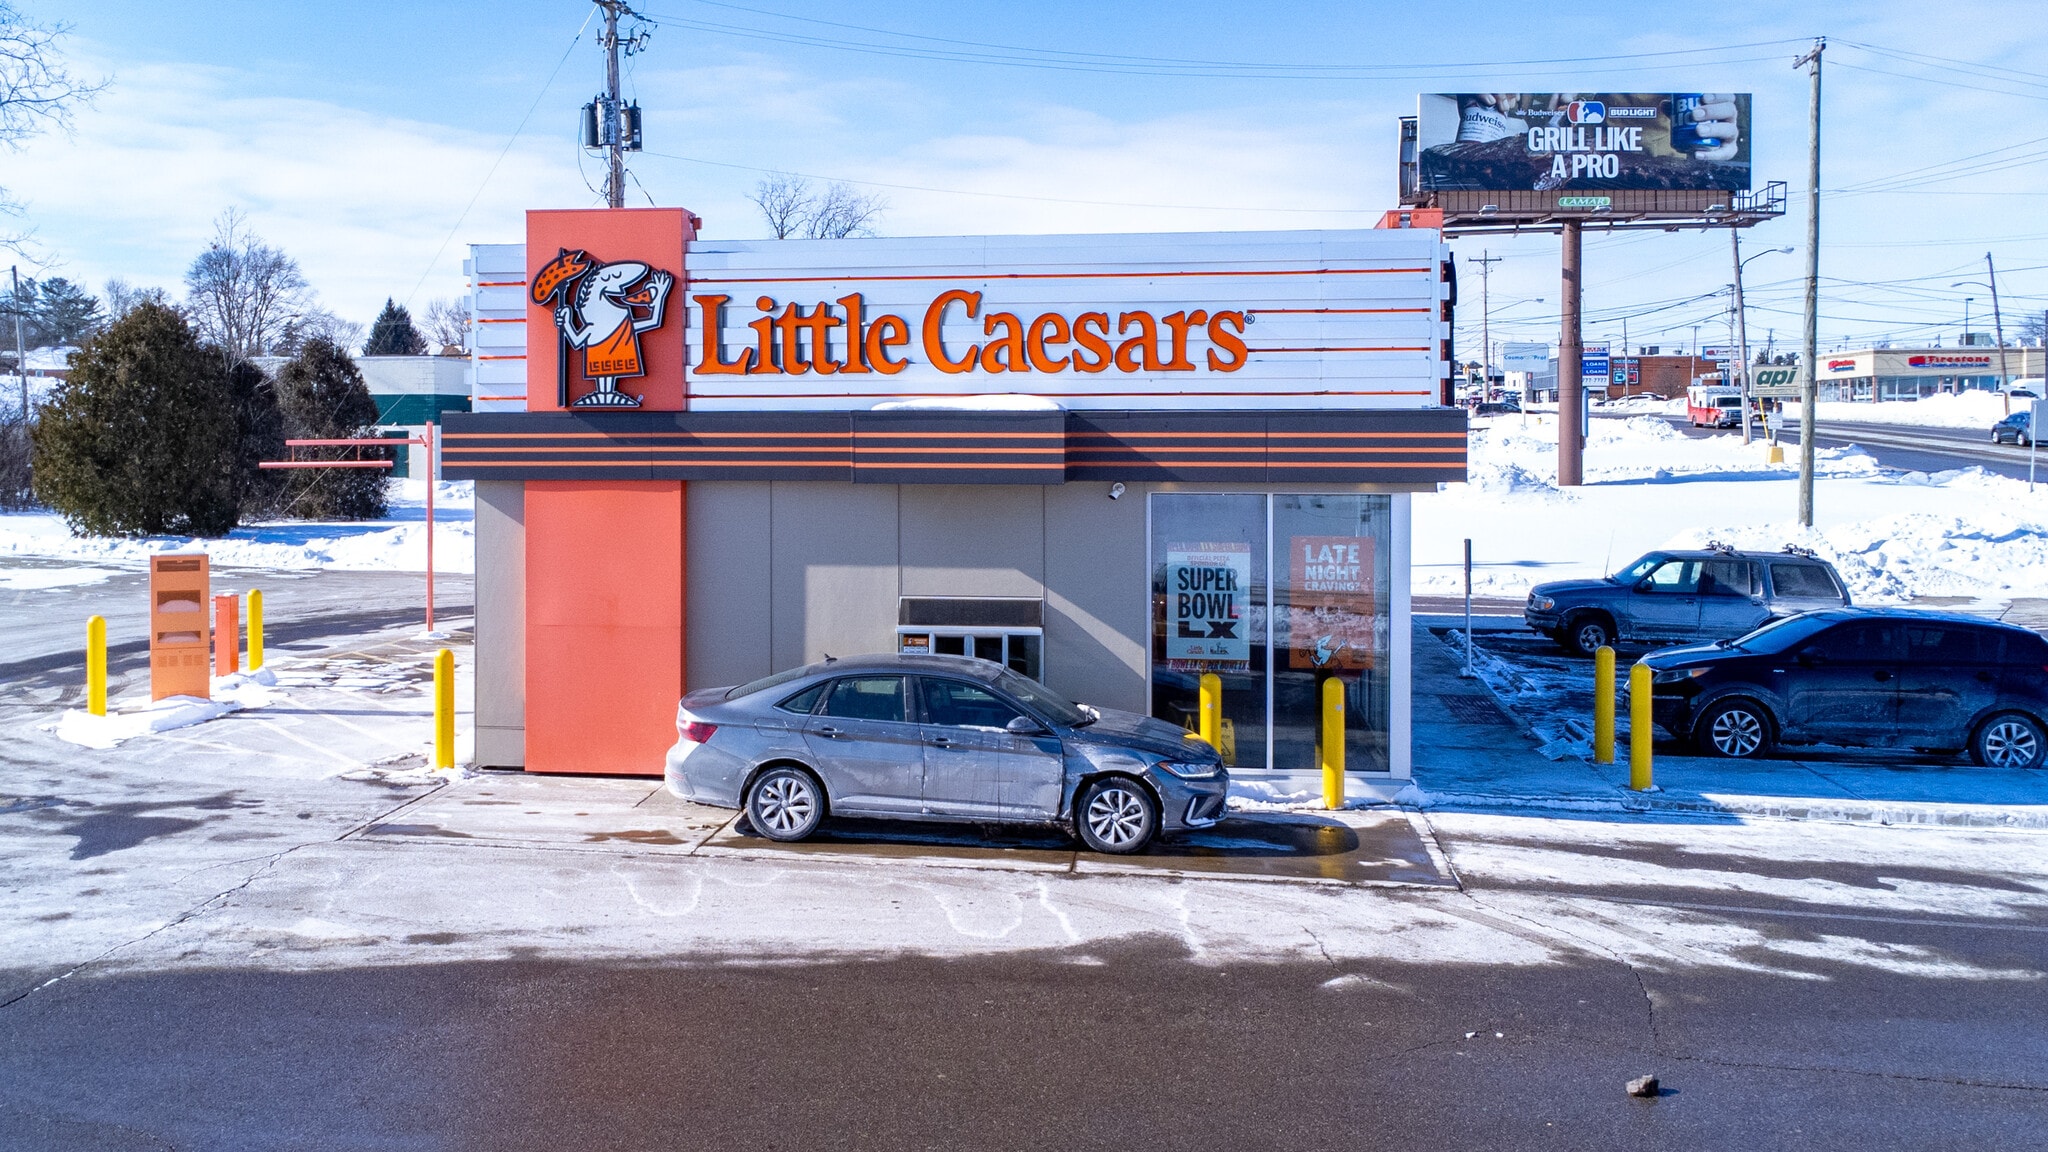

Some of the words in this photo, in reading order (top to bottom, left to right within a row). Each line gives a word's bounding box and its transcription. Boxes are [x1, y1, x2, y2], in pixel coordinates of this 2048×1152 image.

[1610, 109, 1629, 117] BUD
[1629, 109, 1656, 117] LIGHT
[1528, 126, 1591, 152] GRILL
[1595, 126, 1643, 151] LIKE
[1550, 154, 1568, 178] A
[1572, 153, 1619, 179] PRO
[1562, 197, 1605, 206] LAMAR
[692, 292, 909, 376] Little
[921, 288, 1250, 375] Caesars
[1927, 355, 1990, 364] Firestone
[1755, 367, 1798, 387] api
[1305, 544, 1360, 563] LATE
[1177, 567, 1238, 591] SUPER
[1305, 565, 1360, 580] NIGHT
[1304, 581, 1360, 591] CRAVING?
[1178, 593, 1239, 619] BOWL
[1178, 621, 1239, 639] LX
